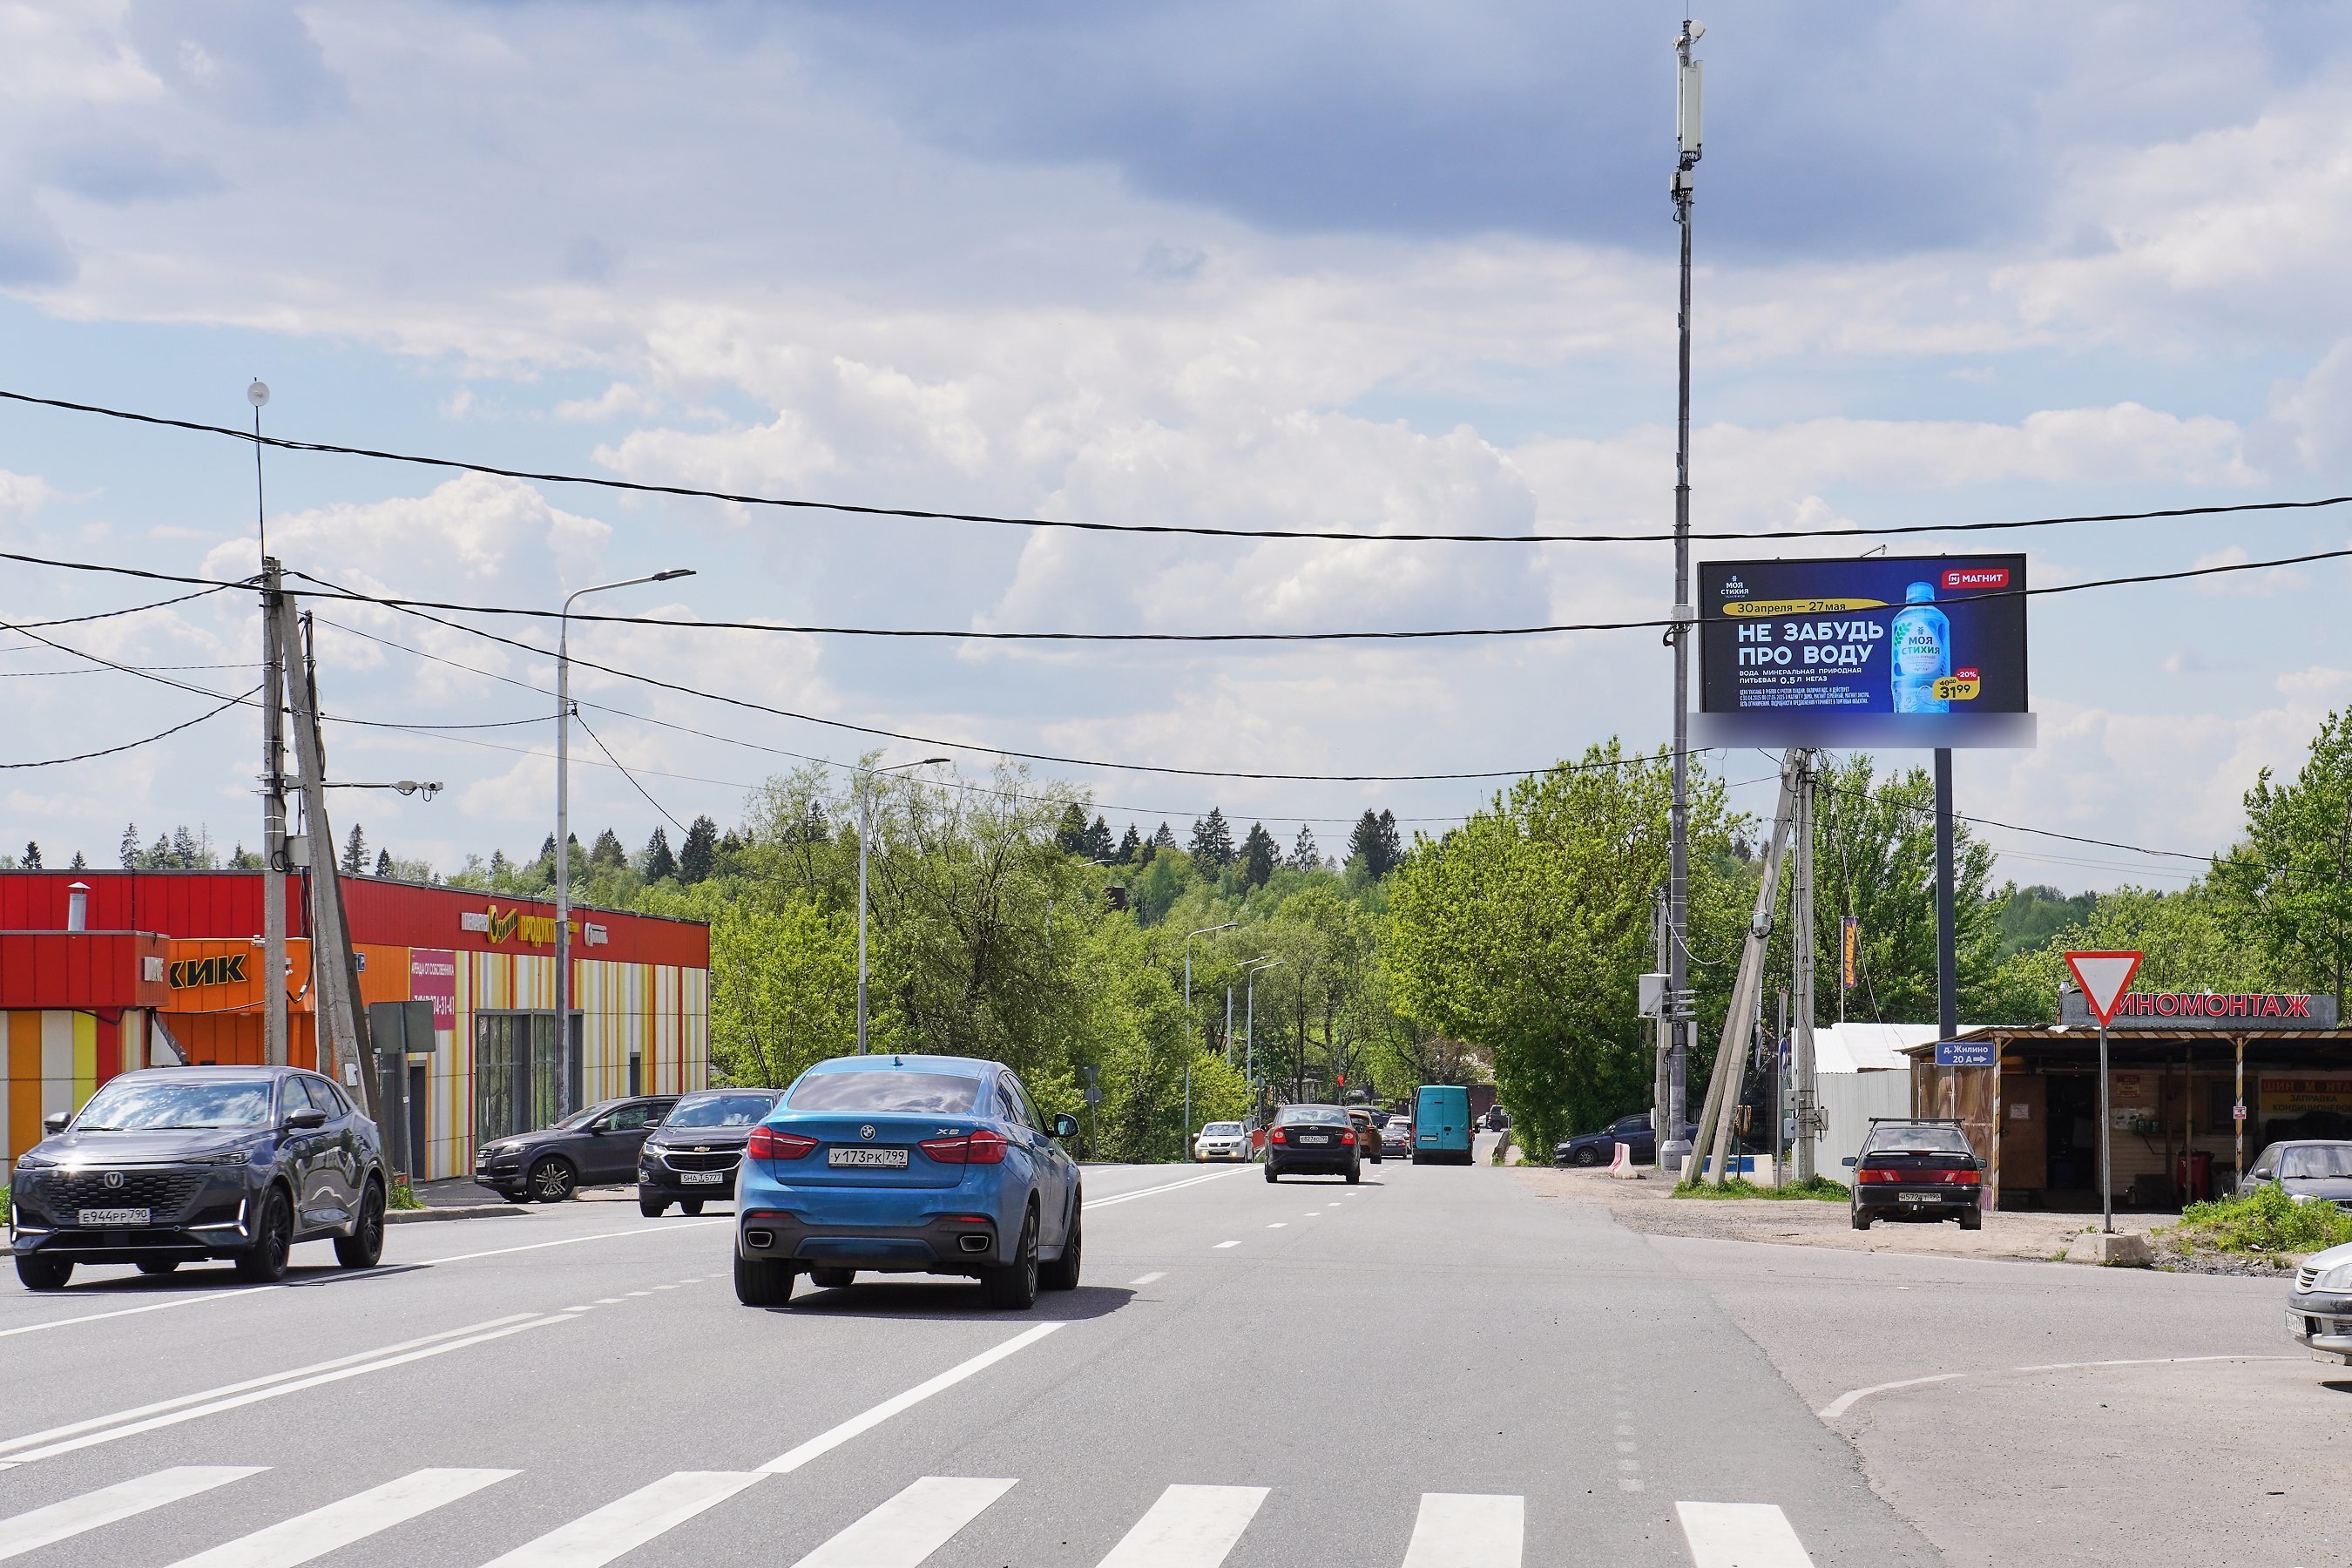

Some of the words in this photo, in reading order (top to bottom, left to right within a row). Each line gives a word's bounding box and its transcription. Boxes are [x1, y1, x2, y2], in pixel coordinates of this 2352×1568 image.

[1737, 603, 1753, 613] 30
[1755, 605, 1792, 614] апреля
[1809, 602, 1824, 612] 27
[1738, 624, 1771, 642] НЕ
[1784, 621, 1884, 642] ЗАБУДЬ
[1739, 646, 1792, 665] ПРО
[1804, 645, 1873, 666] ВОДУ
[1902, 646, 1940, 655] СТИХИЯ
[2089, 993, 2311, 1017] ИНОМОНТАЖ
[2290, 1094, 2338, 1102] ЗАПРАВКА
[834, 1151, 882, 1163] У173РК
[885, 1151, 904, 1160] 799
[83, 1210, 127, 1222] Е944РР
[128, 1210, 147, 1218] 790
